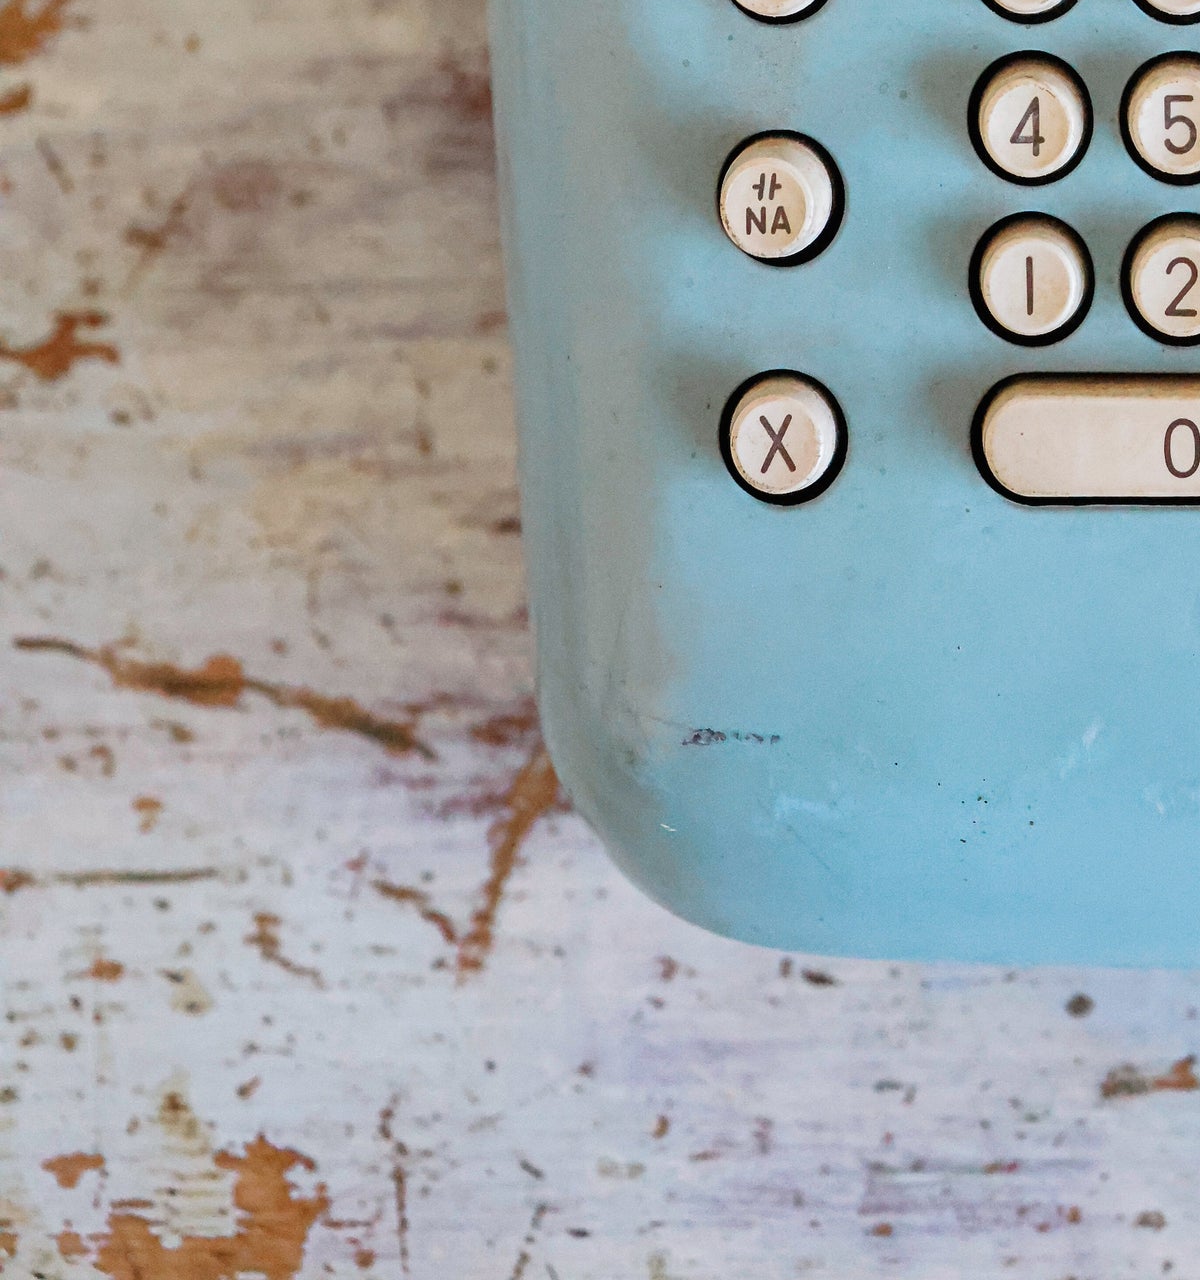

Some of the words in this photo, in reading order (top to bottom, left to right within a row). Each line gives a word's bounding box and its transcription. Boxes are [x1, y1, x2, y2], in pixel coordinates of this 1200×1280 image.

[1009, 96, 1046, 157] 4
[1163, 94, 1198, 155] 5
[745, 205, 792, 236] NA
[1025, 255, 1034, 316] 1
[1164, 256, 1199, 318] 2
[759, 413, 797, 474] X
